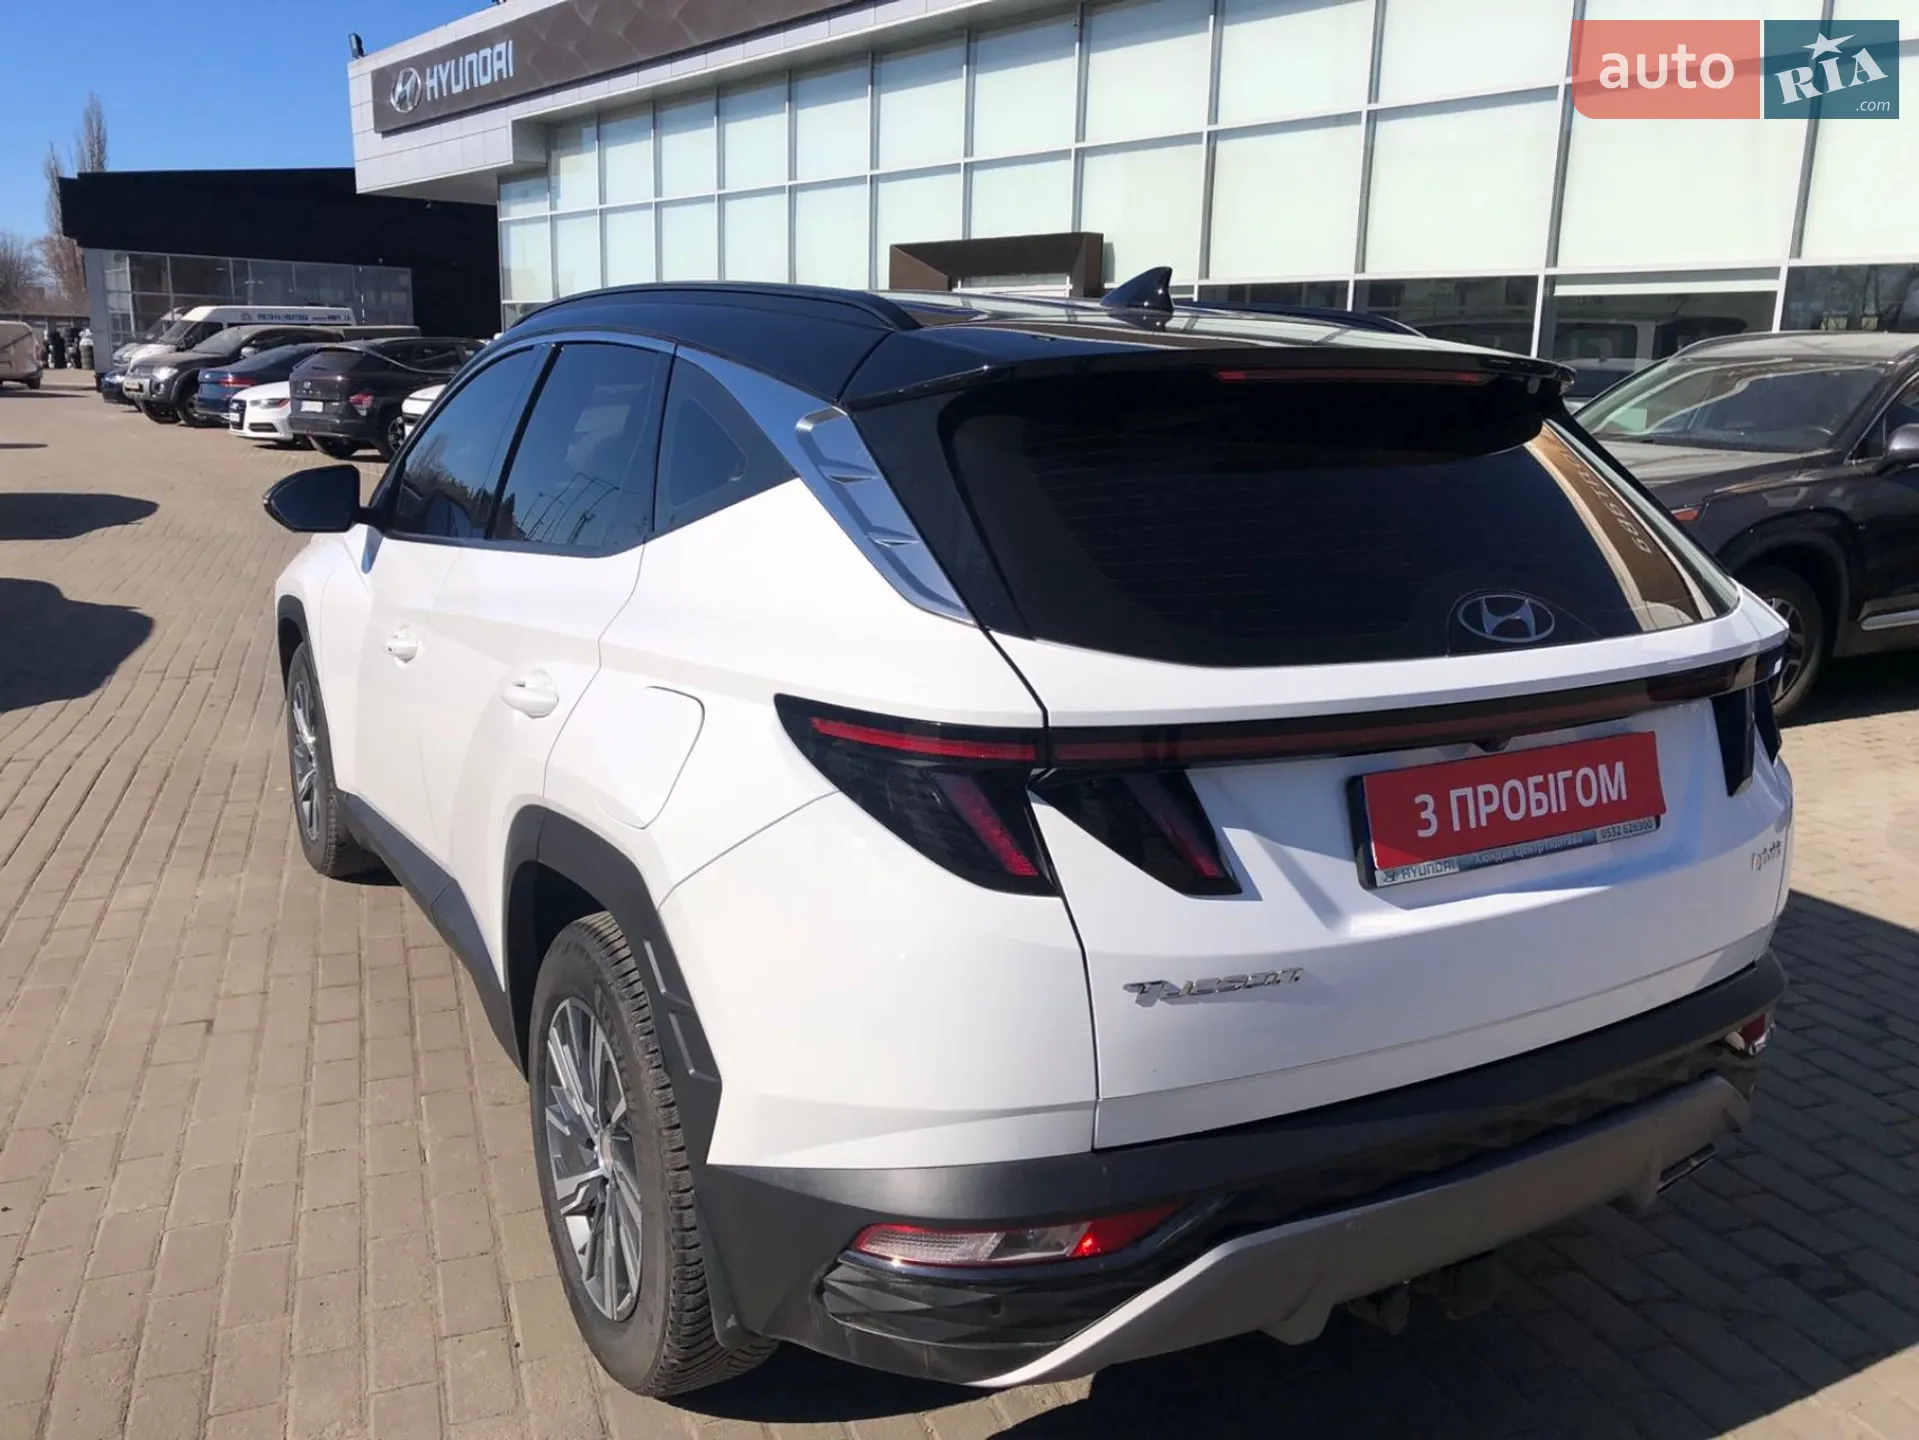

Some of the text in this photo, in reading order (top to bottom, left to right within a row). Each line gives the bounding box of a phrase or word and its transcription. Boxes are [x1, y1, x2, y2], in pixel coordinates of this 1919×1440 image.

[426, 39, 514, 101] HYUNDAI
[1450, 761, 1628, 832] ПРОБІГОМ
[1401, 860, 1458, 880] HYUNDAI
